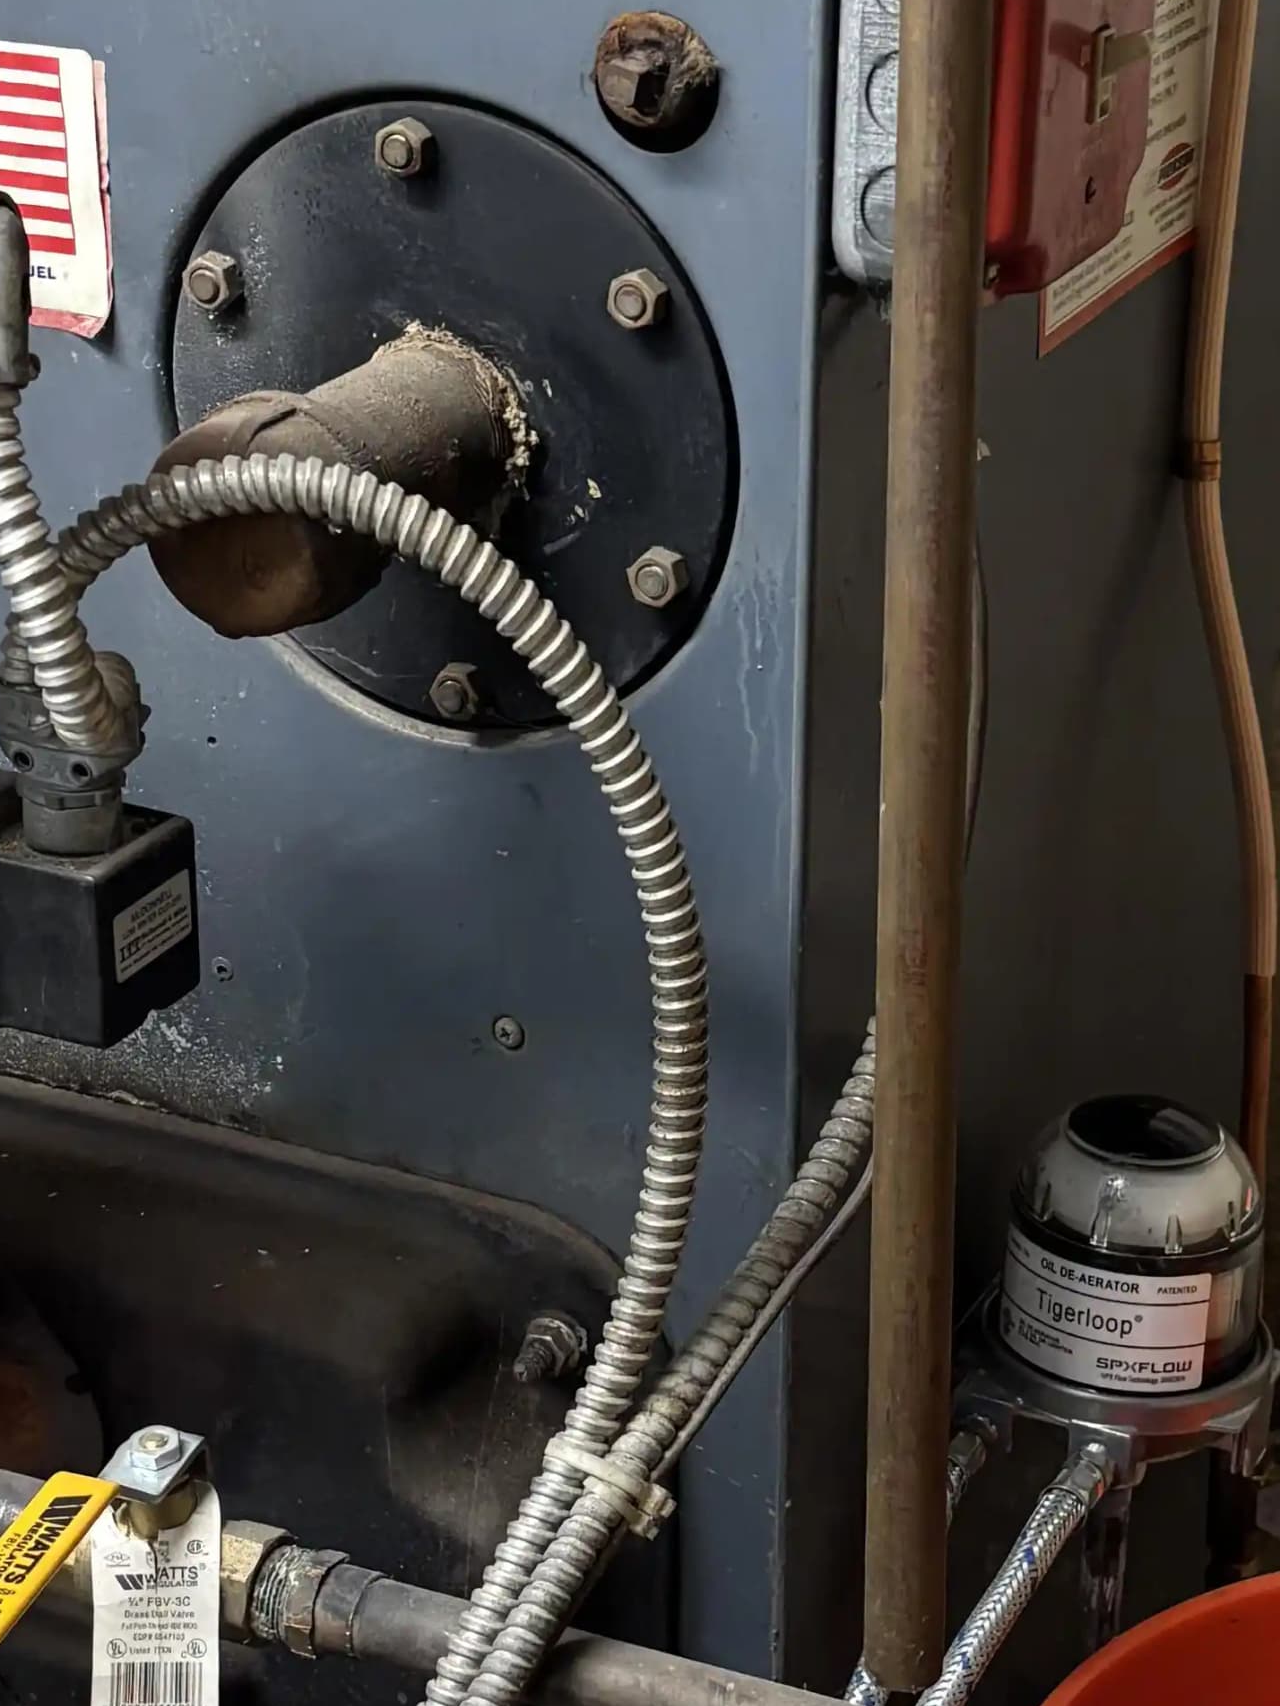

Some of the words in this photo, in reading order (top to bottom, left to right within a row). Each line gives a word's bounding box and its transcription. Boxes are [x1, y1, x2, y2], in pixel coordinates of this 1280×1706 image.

[1041, 1257, 1057, 1274] OIL
[1060, 1266, 1140, 1294] DE-AERATOR
[1157, 1285, 1197, 1295] PATENTED
[4, 1525, 66, 1585] WATTS
[145, 1566, 198, 1583] WATTS
